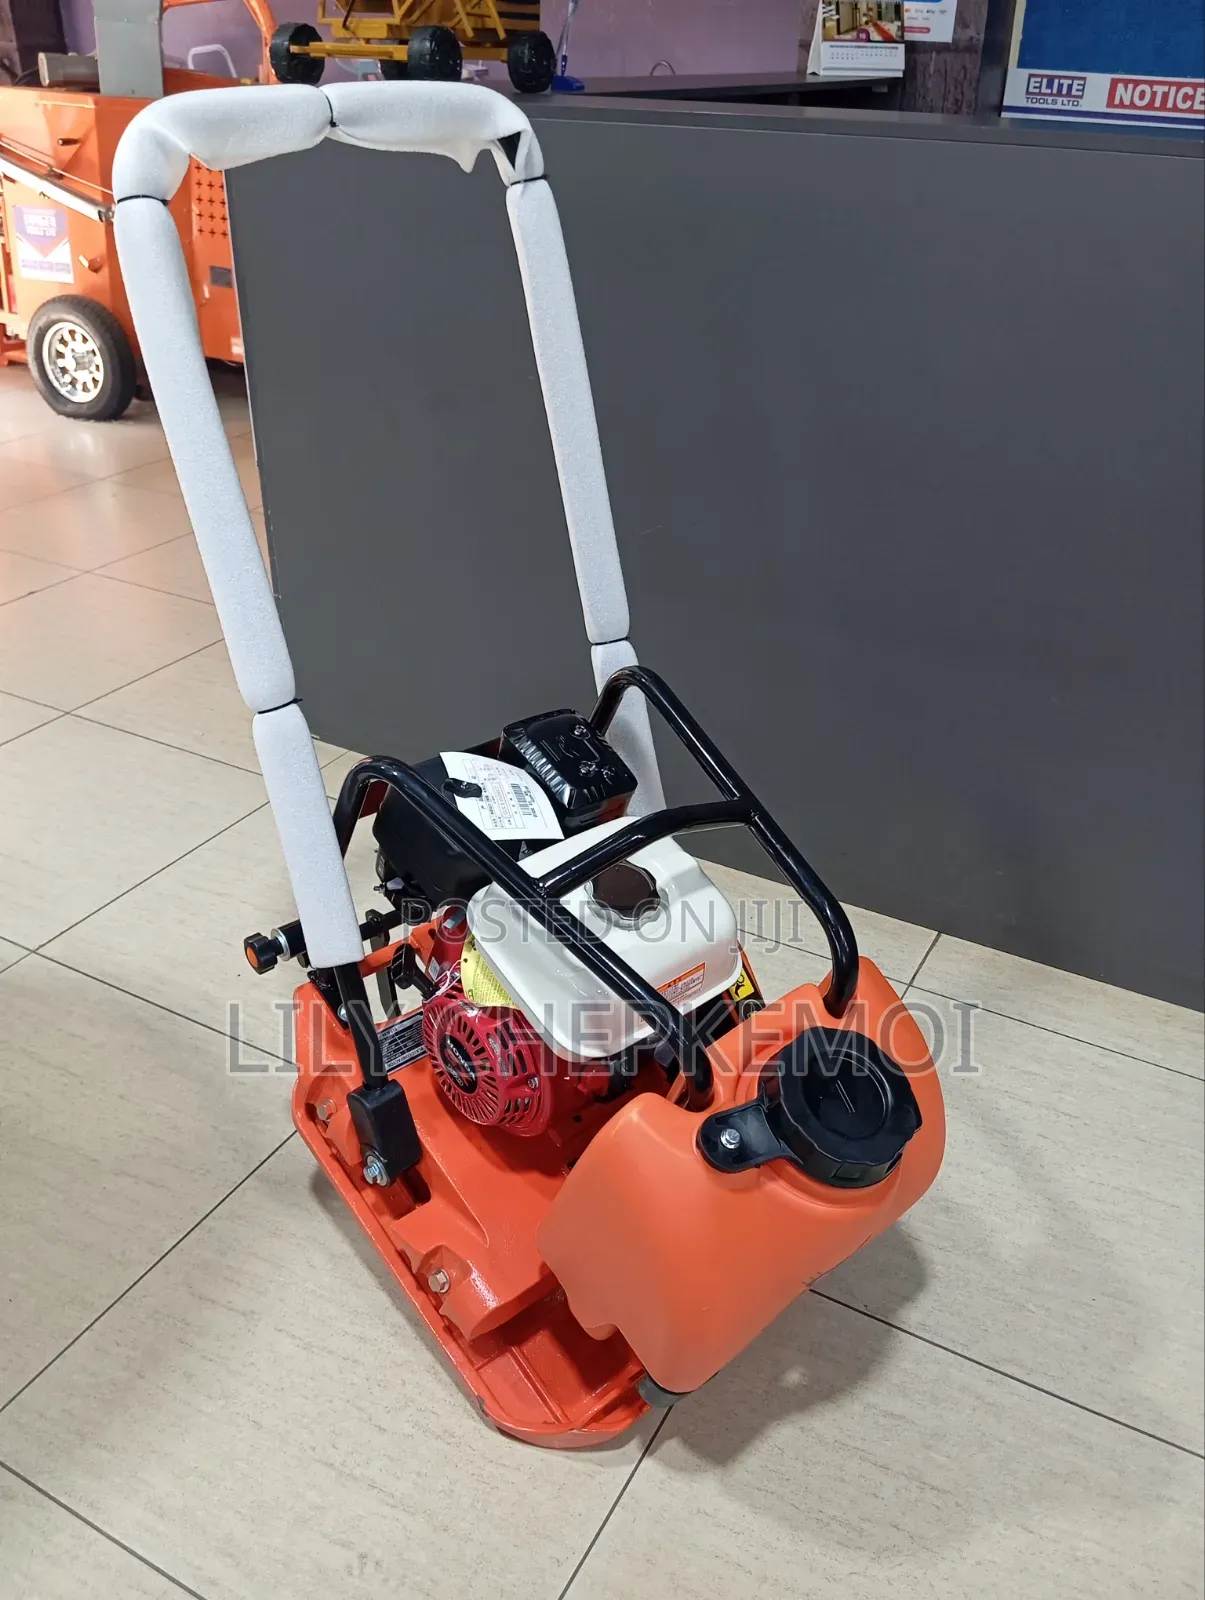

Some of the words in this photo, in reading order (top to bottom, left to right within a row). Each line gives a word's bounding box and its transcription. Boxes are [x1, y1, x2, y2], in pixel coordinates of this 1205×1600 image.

[1028, 77, 1085, 96] ELITE
[1113, 83, 1204, 111] NOTICE
[1025, 97, 1058, 106] TOOLS
[1061, 99, 1083, 108] LTD.
[446, 1038, 476, 1081] HONDA
